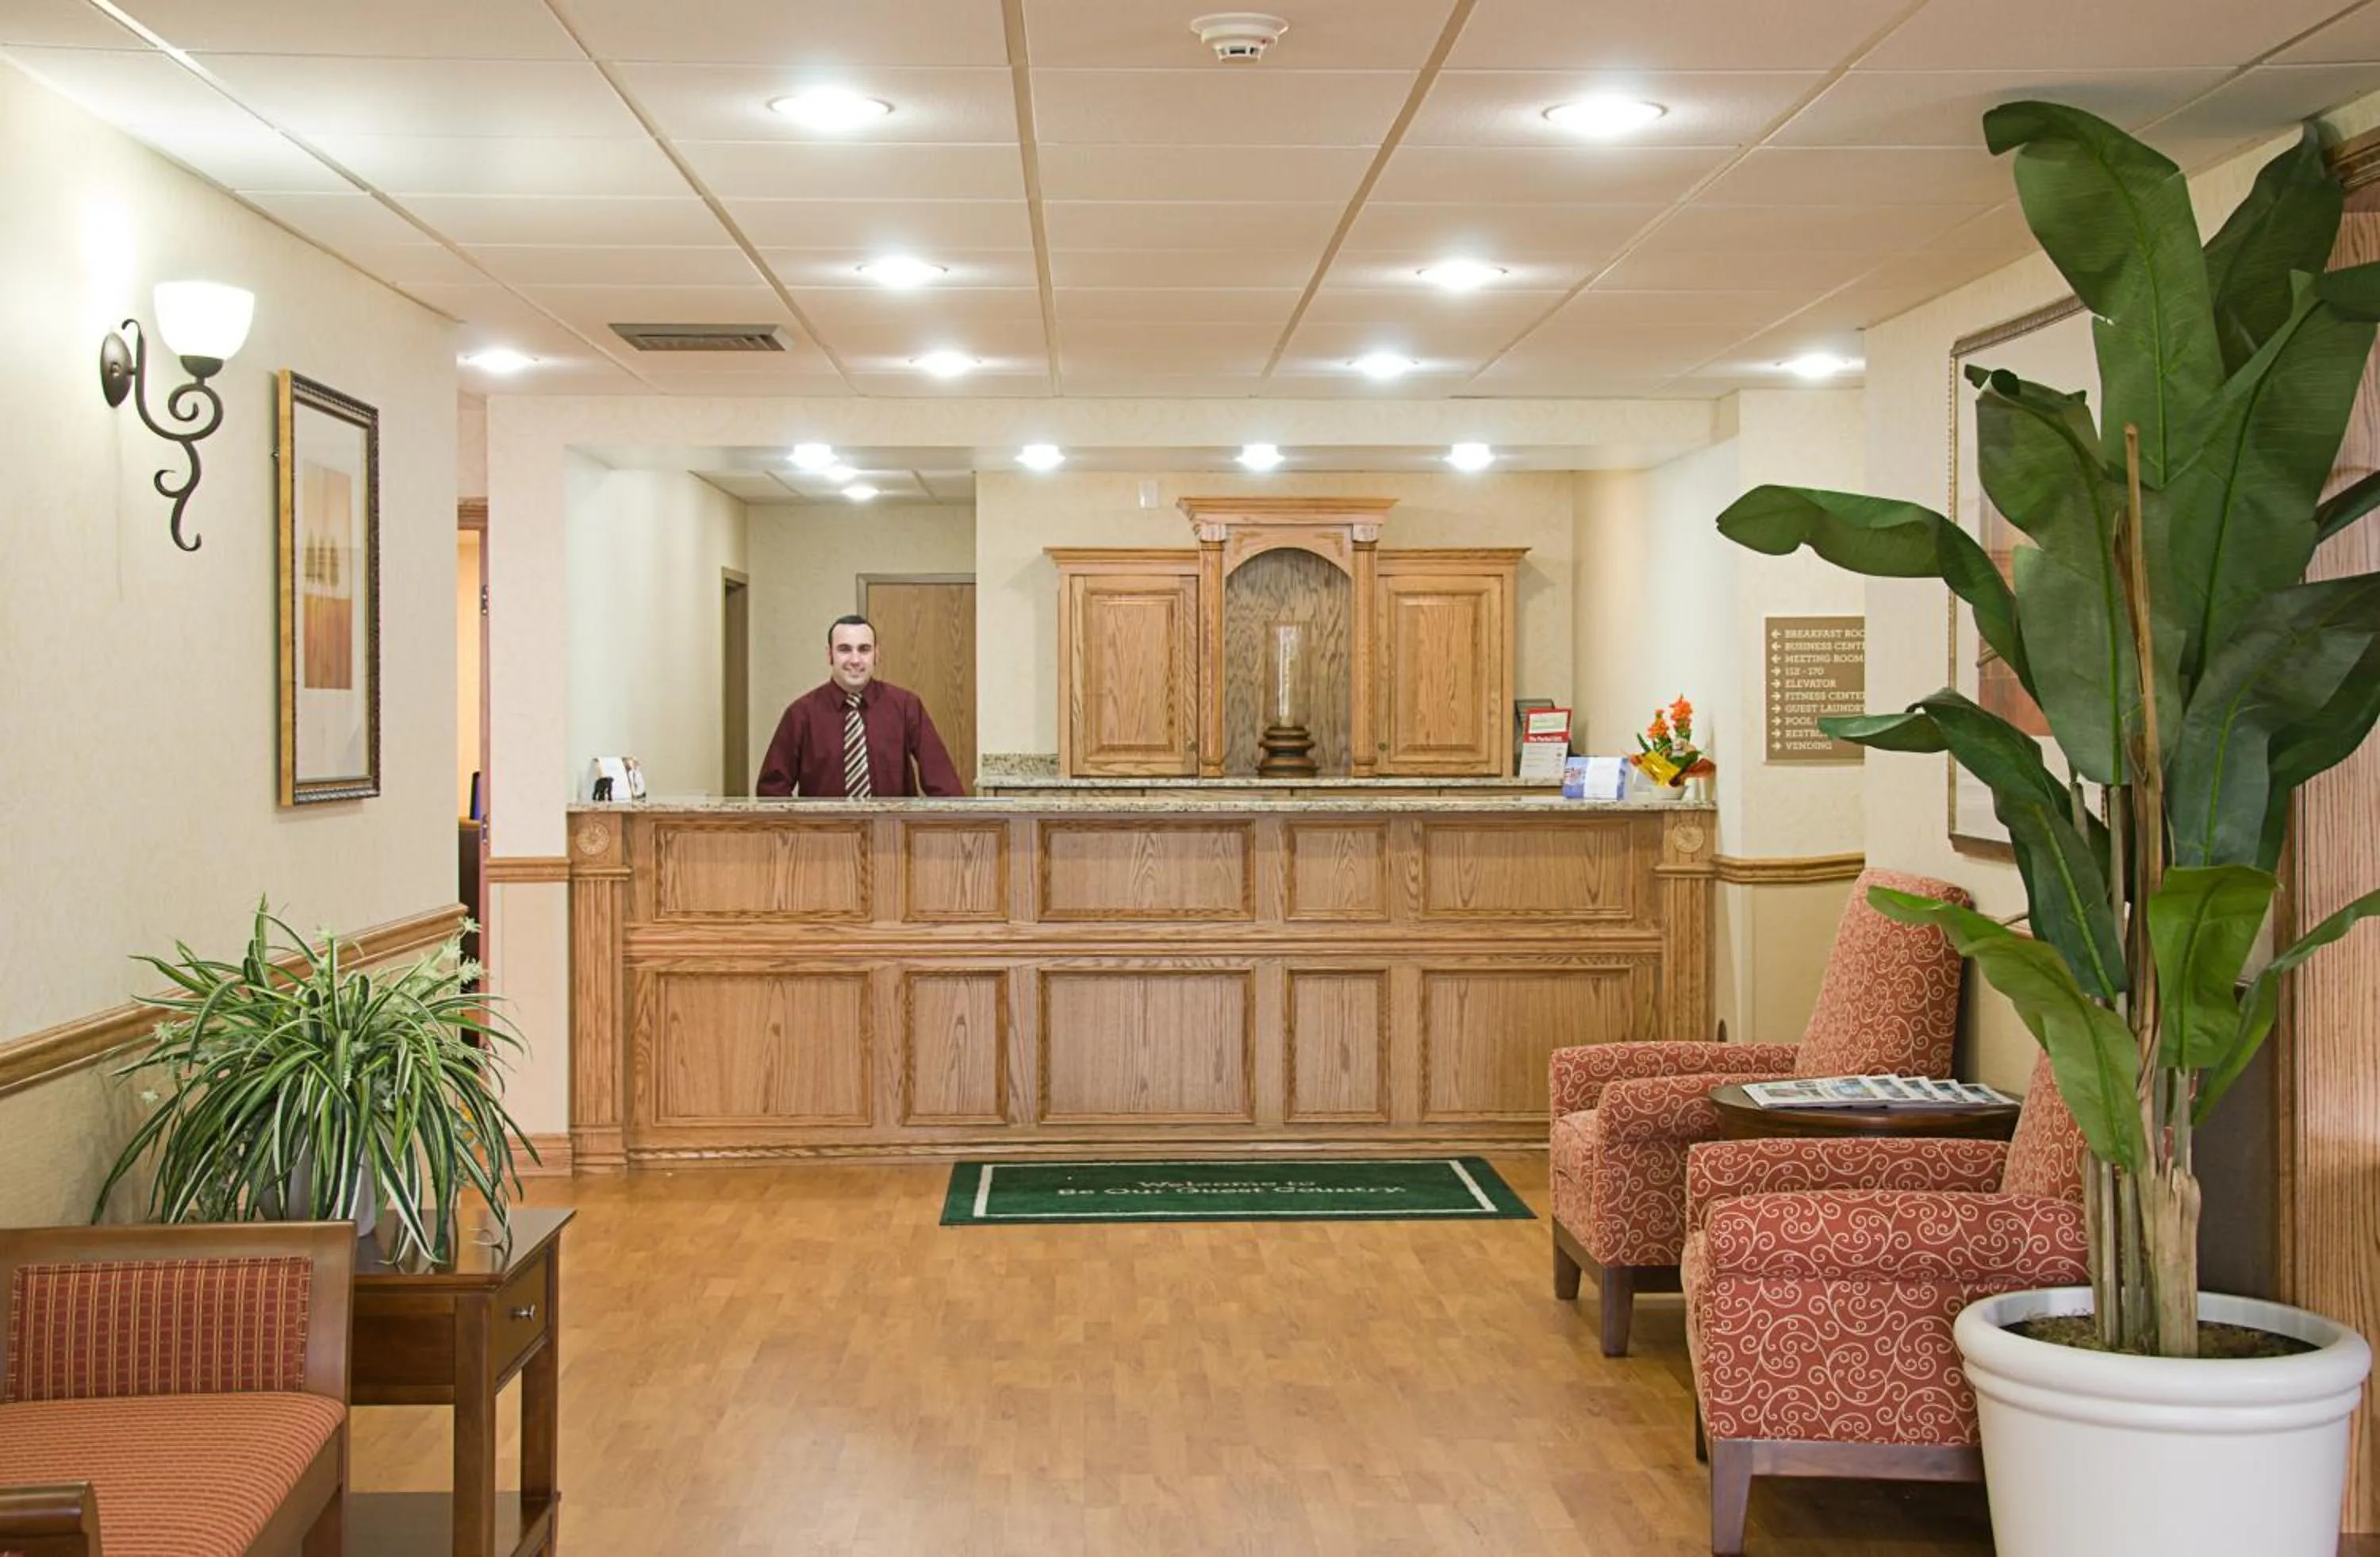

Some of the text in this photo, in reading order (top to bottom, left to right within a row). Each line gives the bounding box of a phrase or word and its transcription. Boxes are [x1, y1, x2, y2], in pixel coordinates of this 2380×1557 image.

[1785, 629, 1842, 638] BREAKFAST
[1785, 641, 1865, 651] BUSINESS CENT
[1785, 654, 1830, 663] MEETING
[1785, 679, 1837, 688] ELEVATOR
[1785, 691, 1865, 700] FITNESS CENTE
[1785, 704, 1818, 713] GUEST
[1785, 717, 1812, 726] POOL
[1786, 741, 1832, 751] VENDING
